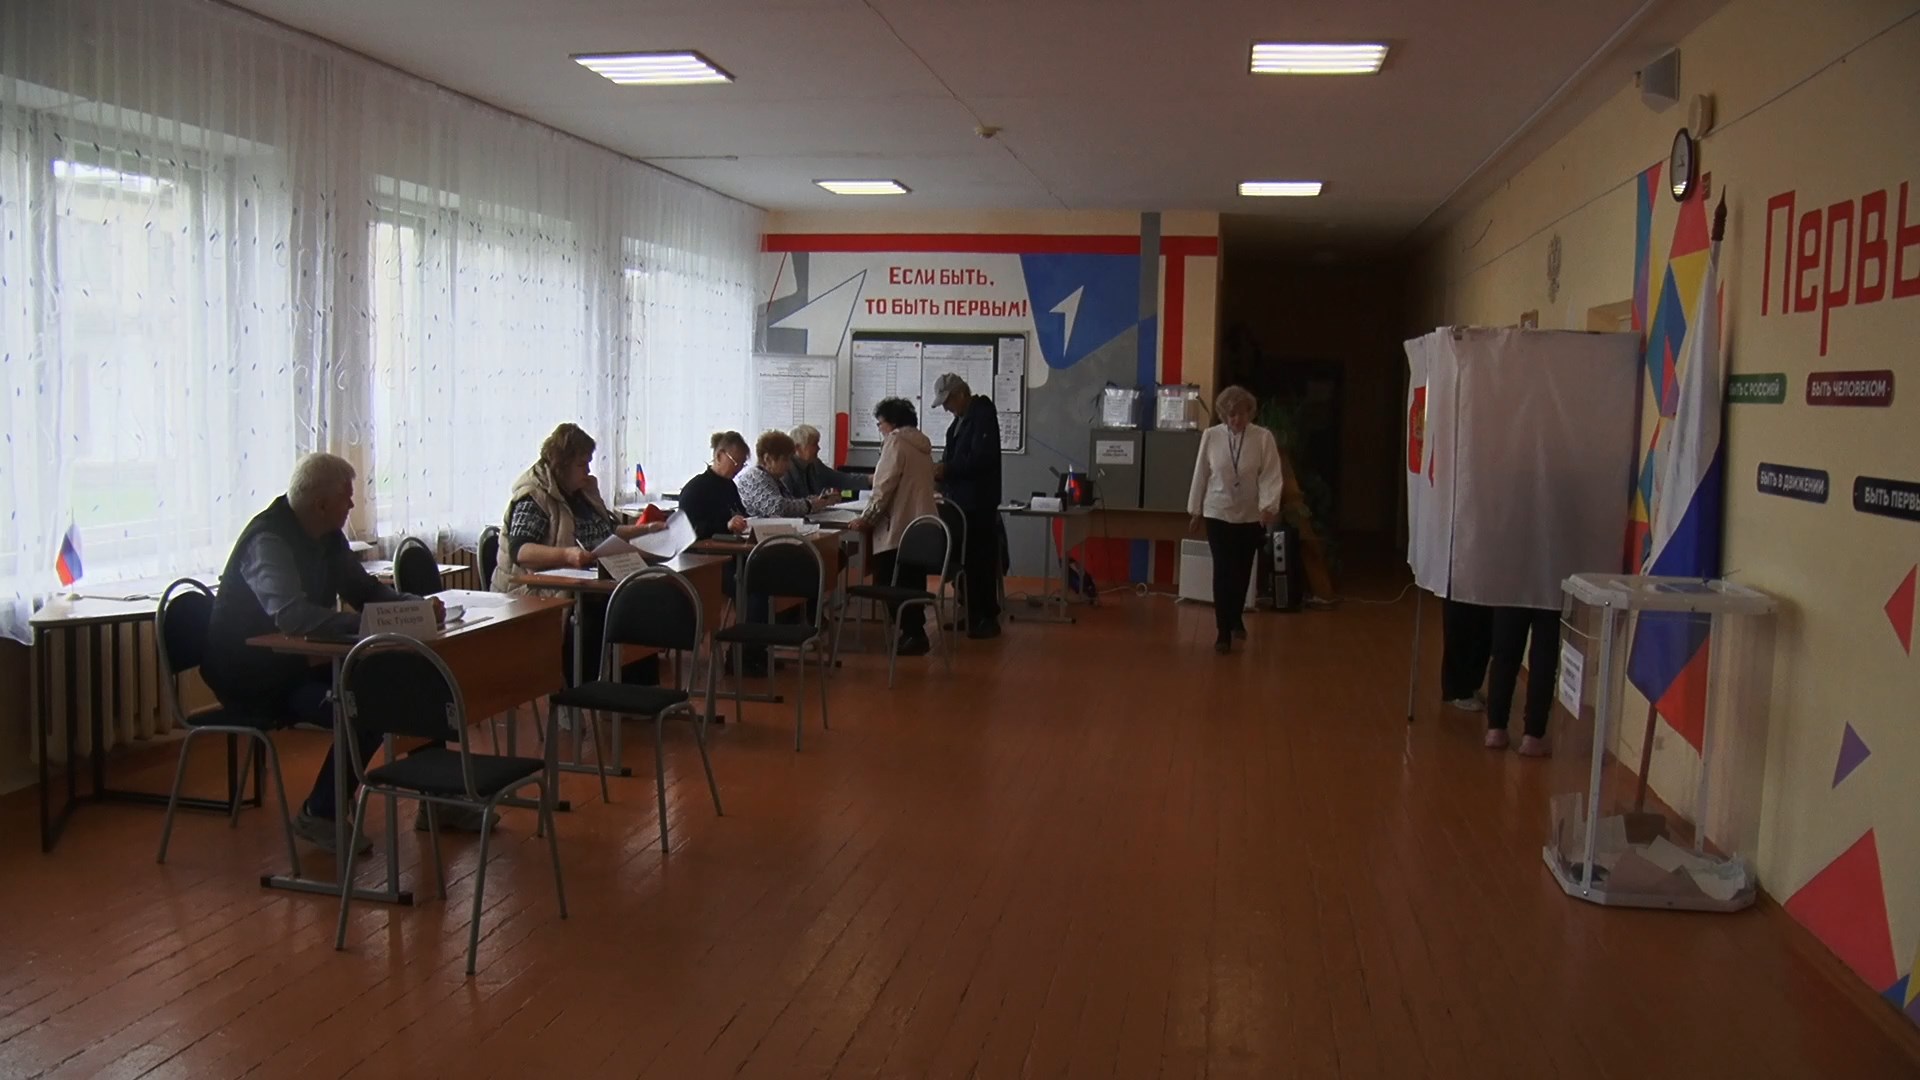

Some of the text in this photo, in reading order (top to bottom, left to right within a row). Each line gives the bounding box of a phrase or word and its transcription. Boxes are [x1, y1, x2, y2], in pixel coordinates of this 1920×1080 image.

[865, 299, 1027, 317] ТО БЫТЬ ПЕРВЫМ!
[1749, 378, 1780, 396] РОССИЕЙ
[1811, 379, 1887, 397] БЫТЬ ЧЕЛОВЕКОМ
[1760, 470, 1825, 496] БЫТЬ В ДВИЖЕНИИ
[1864, 486, 1889, 506] БЫТЬ
